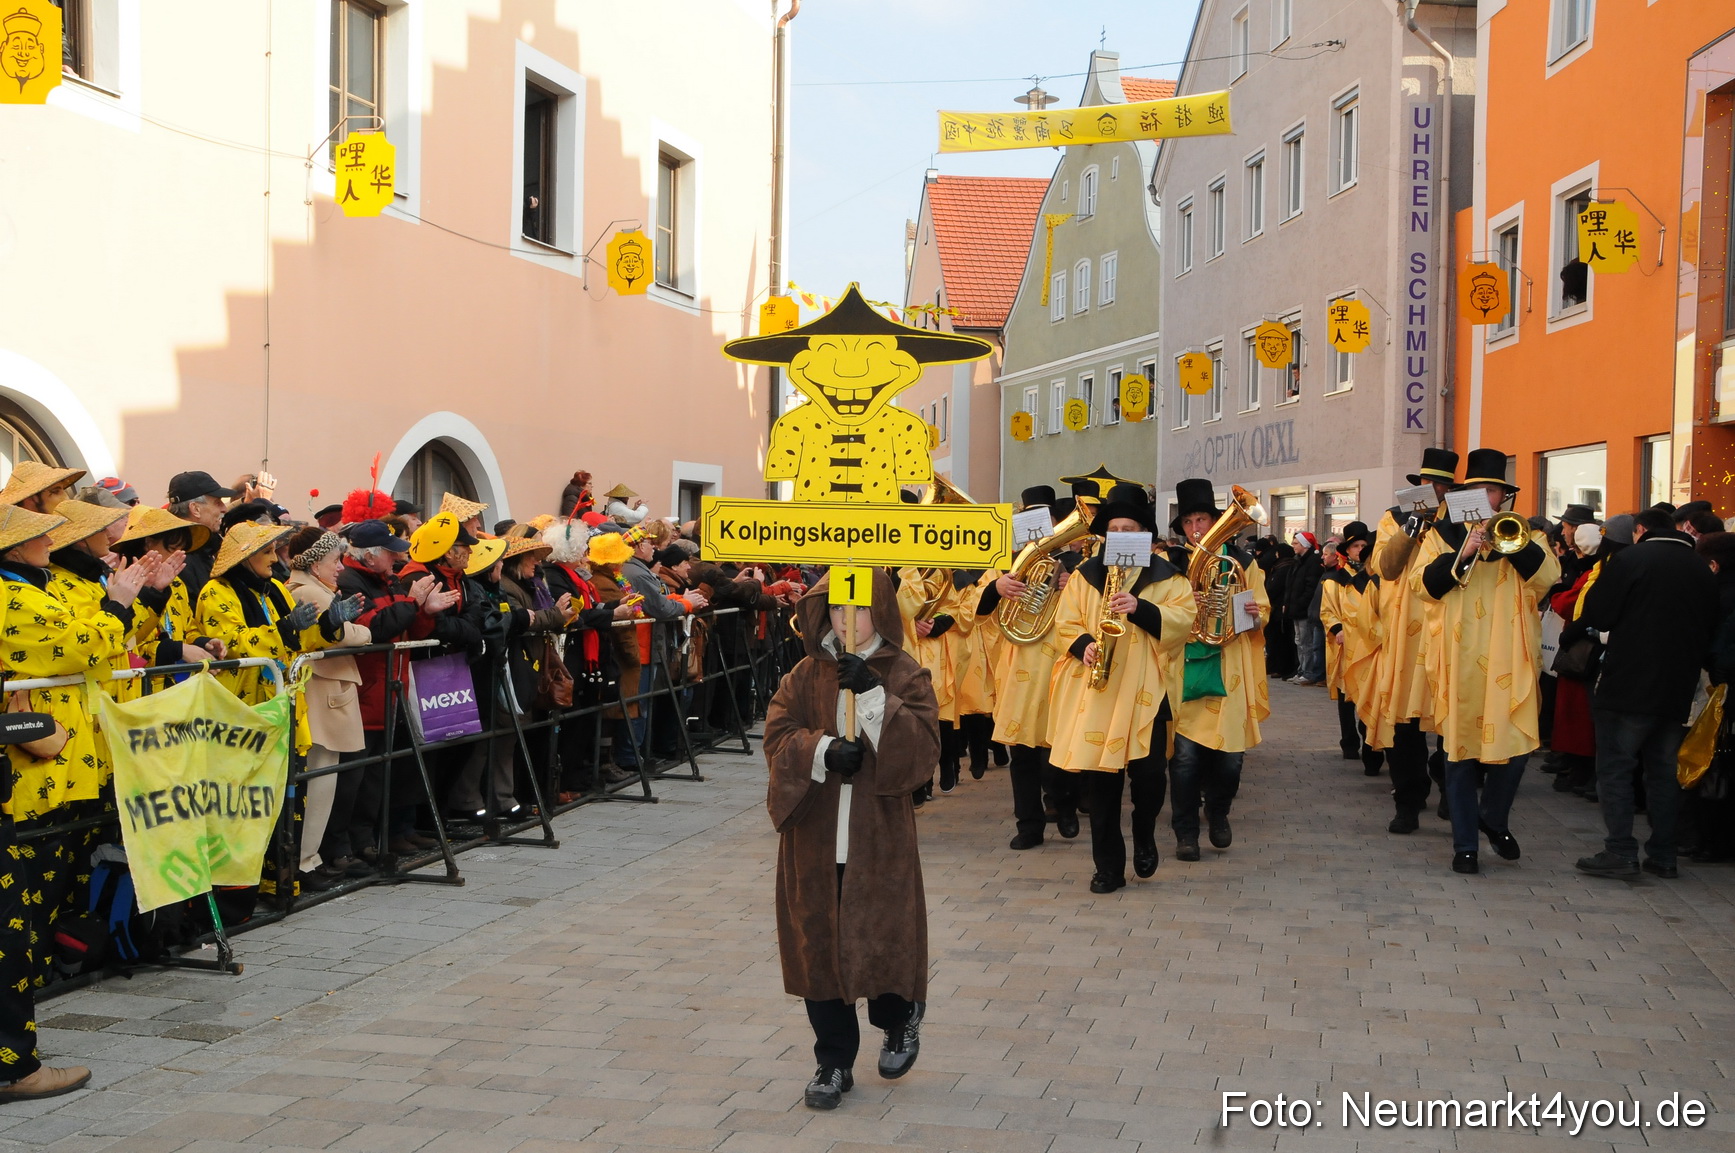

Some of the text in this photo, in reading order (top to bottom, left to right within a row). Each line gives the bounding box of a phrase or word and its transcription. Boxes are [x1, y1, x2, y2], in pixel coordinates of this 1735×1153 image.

[341, 178, 360, 205] 人
[1587, 242, 1606, 264] 人
[1406, 107, 1431, 429] UHREN SCHMUCK
[1334, 328, 1347, 345] 人
[1204, 418, 1300, 475] OPTIK OEXL
[720, 519, 992, 551] Kolpingskapelle Töging
[844, 572, 855, 600] 1
